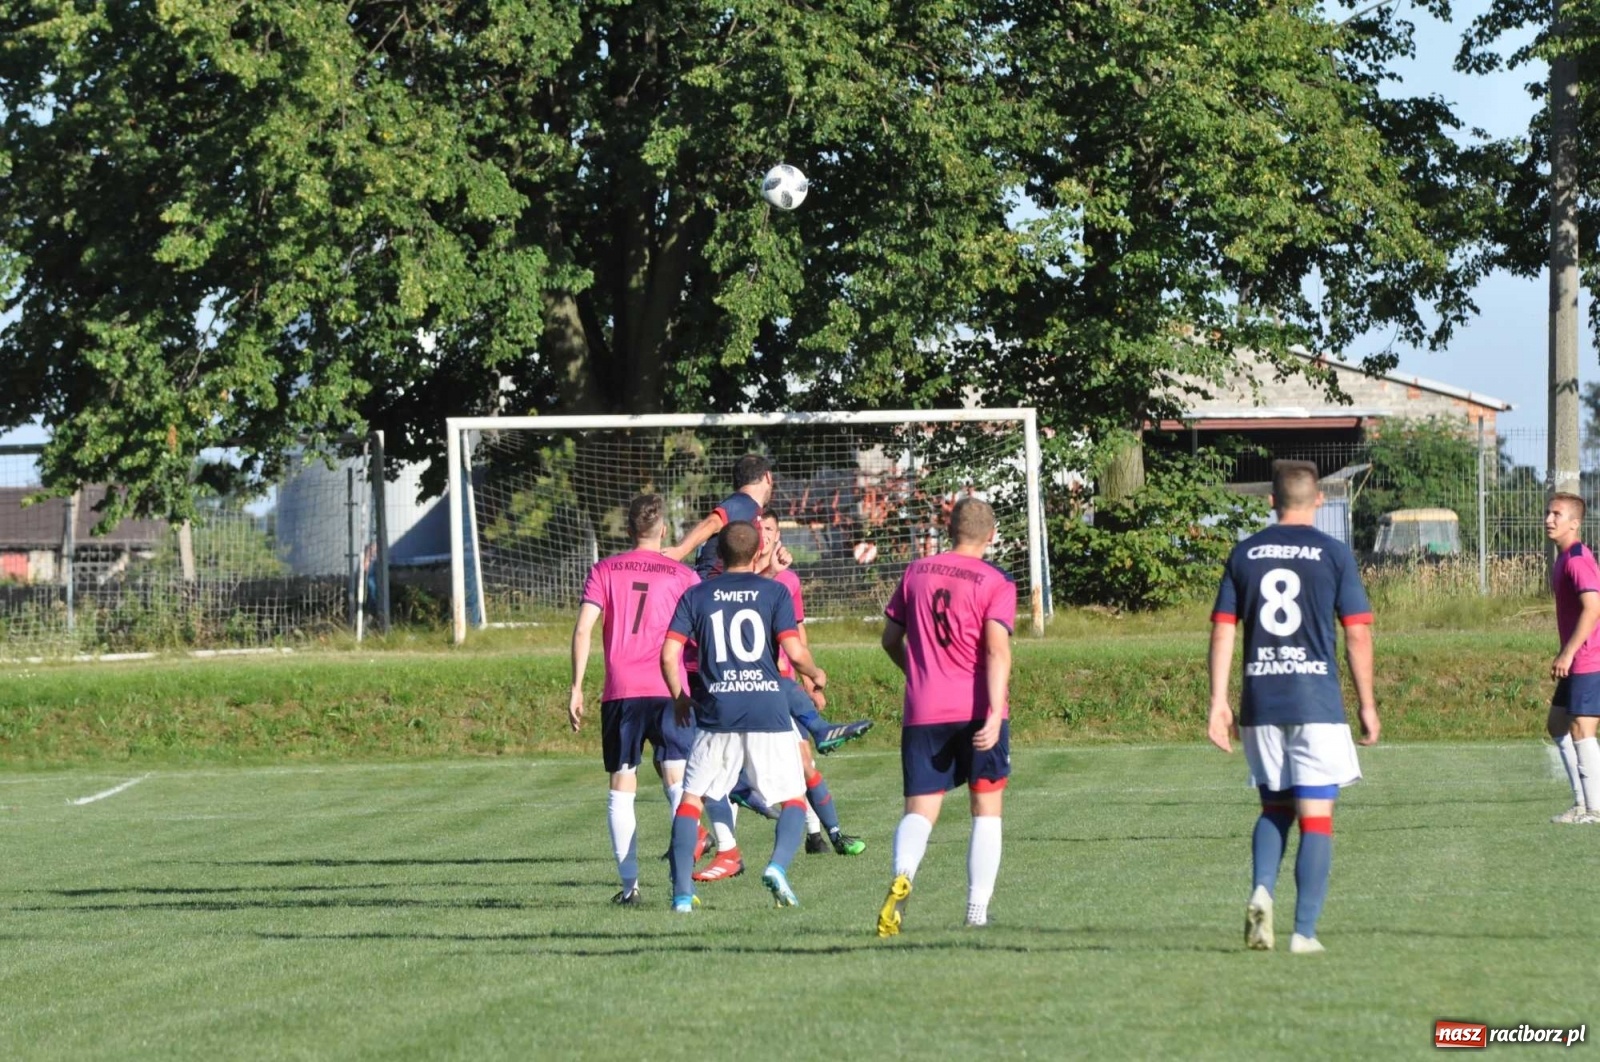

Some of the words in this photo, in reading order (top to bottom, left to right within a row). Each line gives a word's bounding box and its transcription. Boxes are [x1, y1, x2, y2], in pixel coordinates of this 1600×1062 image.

[1246, 544, 1323, 561] CZEREPAK
[610, 562, 623, 572] LKS
[713, 588, 759, 603] ŚWIĘTY
[1259, 568, 1302, 637] 8
[631, 581, 649, 635] 7
[710, 608, 765, 663] 10
[1257, 646, 1276, 661] KS
[1277, 645, 1307, 660] 1905
[723, 669, 737, 681] KS
[739, 669, 763, 681] 1905
[709, 680, 780, 693] KRZANOWICE
